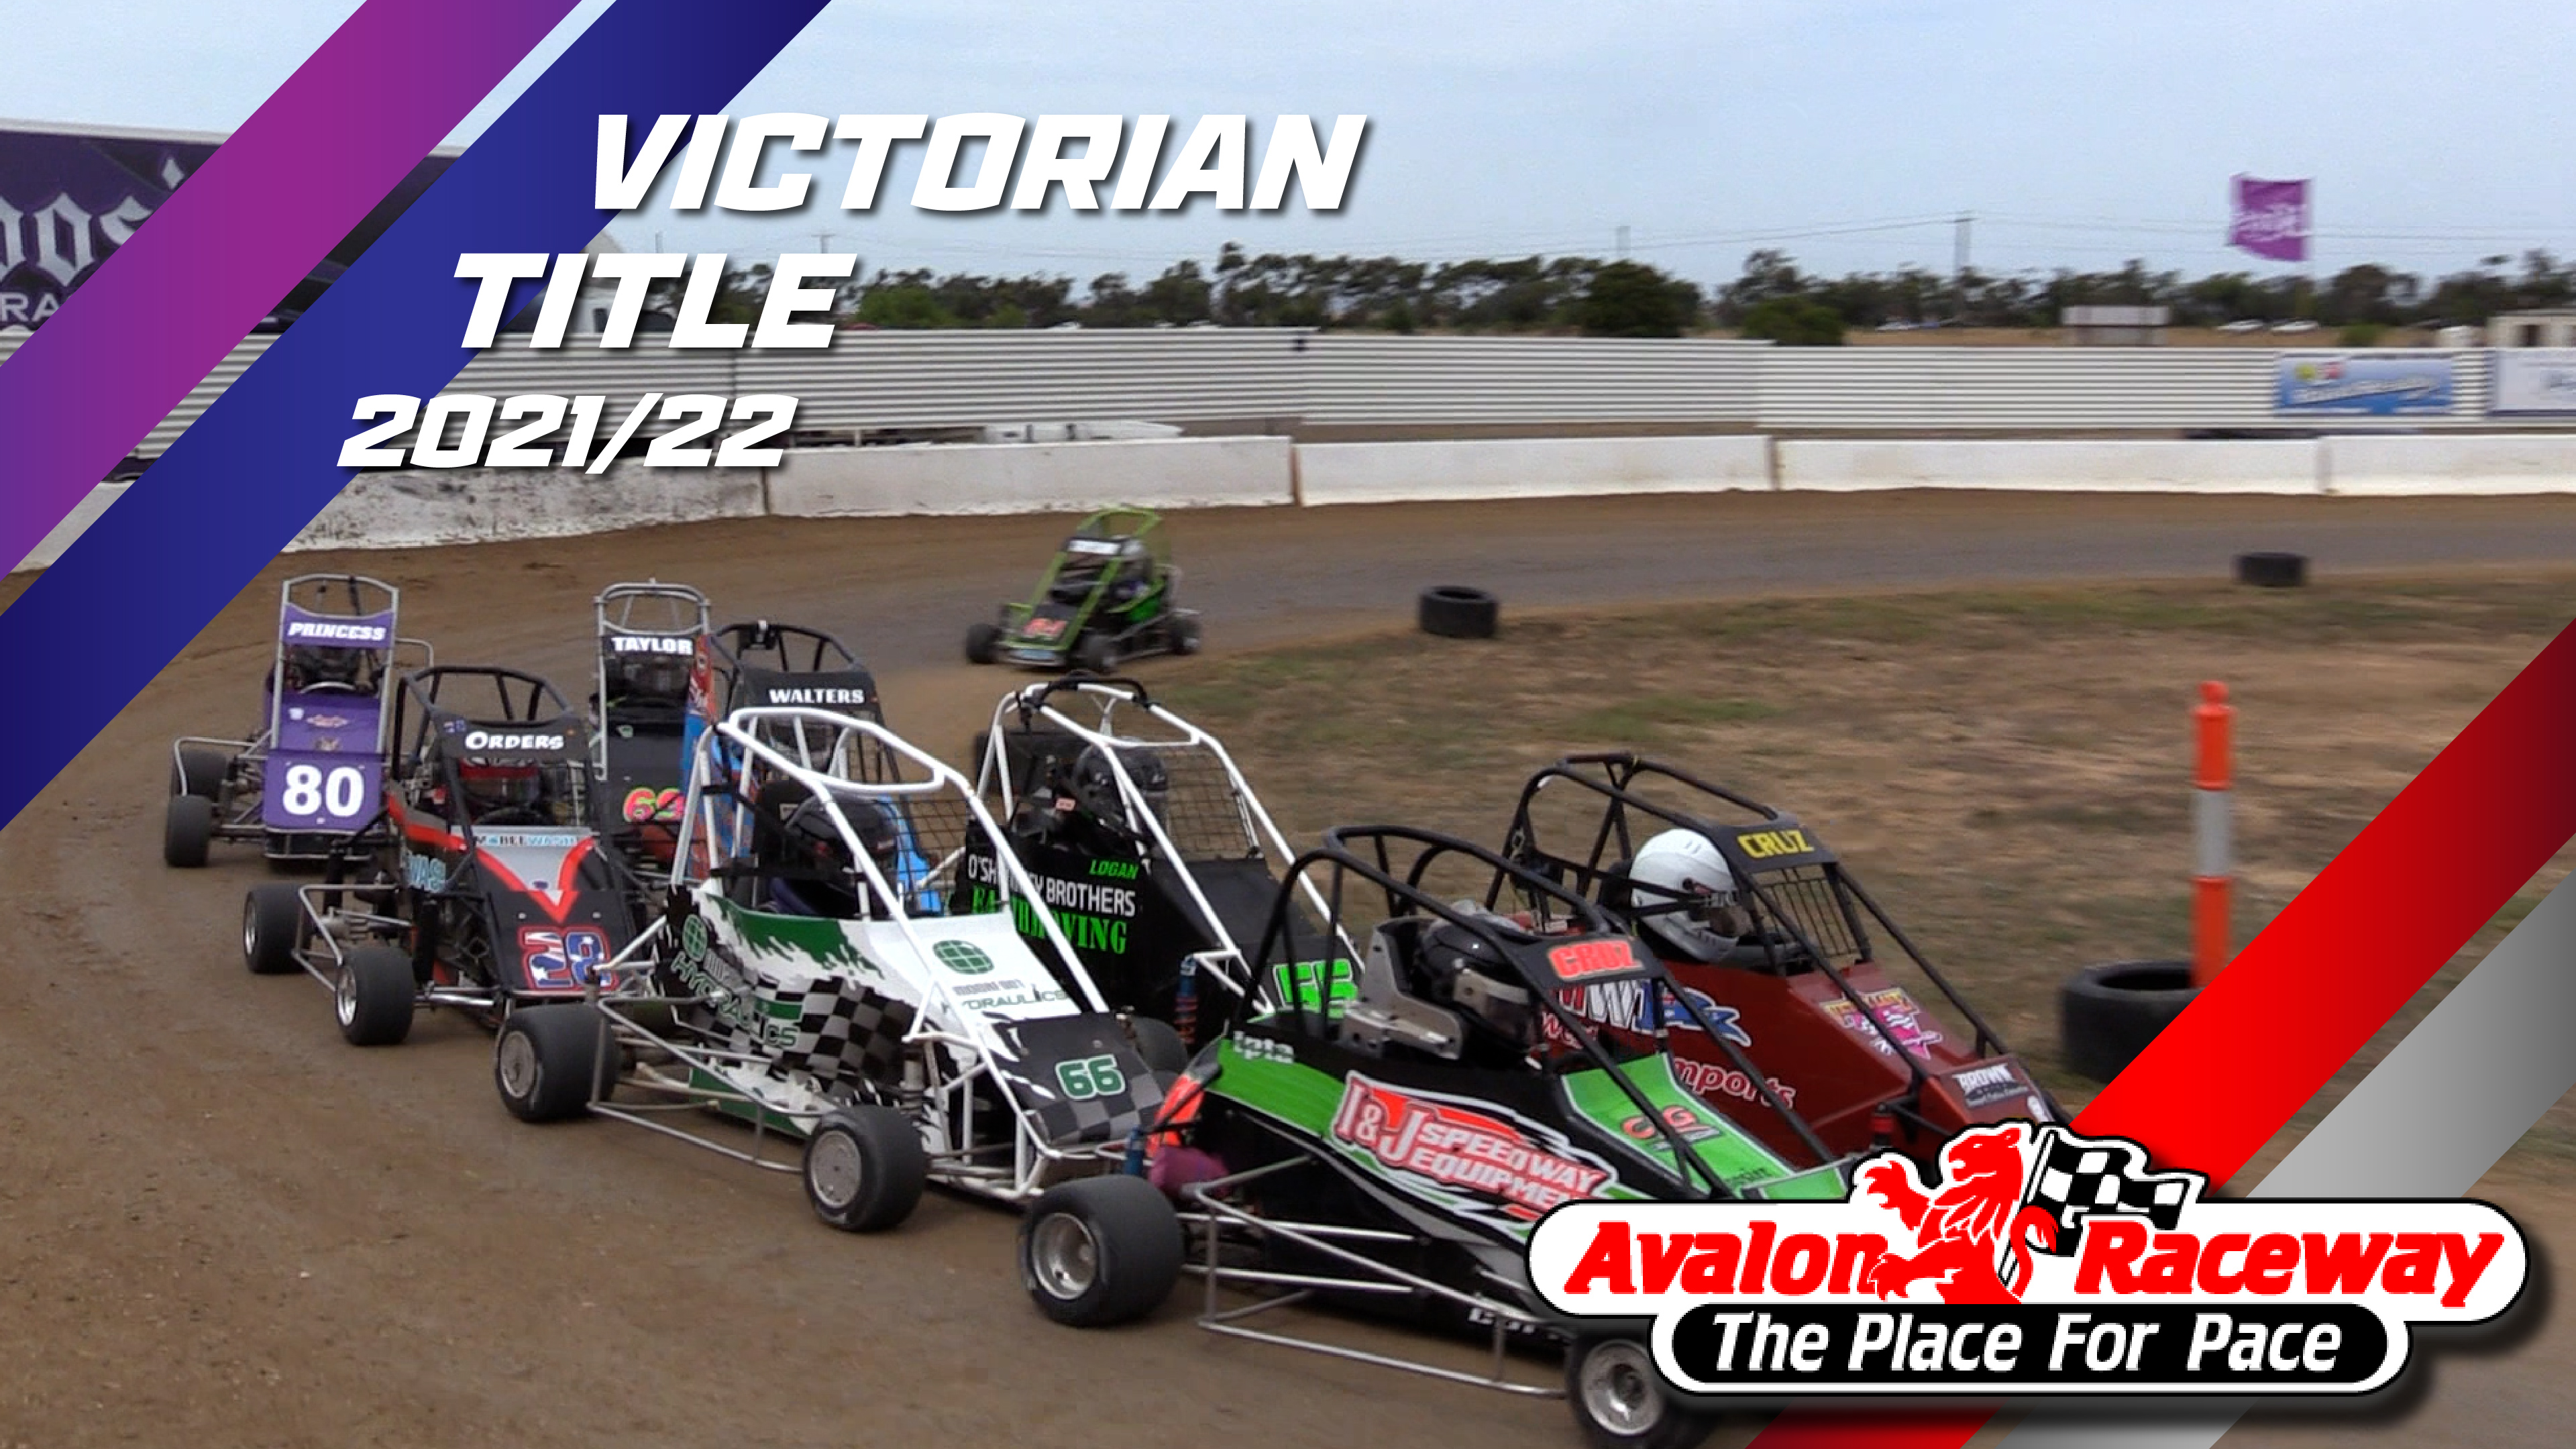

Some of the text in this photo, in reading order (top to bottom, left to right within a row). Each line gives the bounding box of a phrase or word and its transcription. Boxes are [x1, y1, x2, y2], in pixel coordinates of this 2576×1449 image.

[288, 623, 386, 641] PRINCESS
[611, 637, 694, 655] TAYLOR
[769, 688, 864, 704] WALTERS
[282, 765, 364, 817] 80
[1738, 828, 1815, 859] CRUZ
[1089, 859, 1139, 880] LOGAN
[1046, 876, 1136, 918] BROTHERS
[1548, 940, 1645, 980] CRUZ
[1055, 1054, 1127, 1100] 66
[1419, 1124, 1606, 1191] SPEEDWAY
